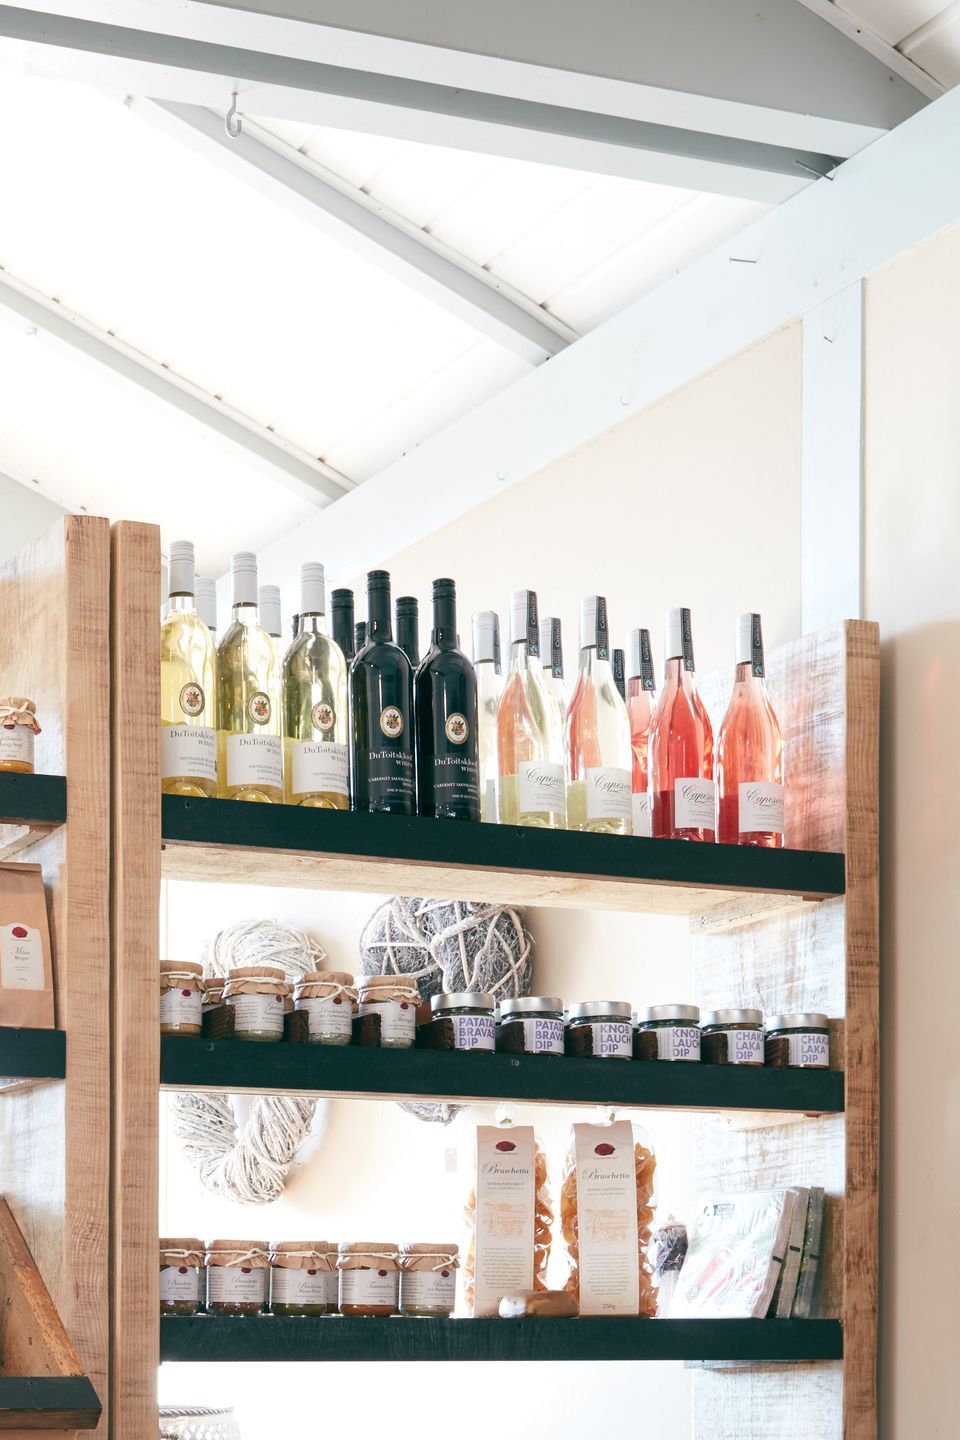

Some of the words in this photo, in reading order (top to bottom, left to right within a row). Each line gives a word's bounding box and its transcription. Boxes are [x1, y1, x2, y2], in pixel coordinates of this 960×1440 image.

[459, 1017, 495, 1029] PATATA
[600, 1023, 630, 1034] KNOB
[672, 1028, 700, 1039] KNOB
[535, 1030, 564, 1041] BRAVA
[600, 1034, 631, 1044] LAUCH
[459, 1037, 478, 1047] DIP
[535, 1041, 553, 1050] DIP
[672, 1038, 700, 1048] LAUCH
[736, 1041, 761, 1051] LAKA
[600, 1043, 618, 1053] DIP
[672, 1048, 690, 1058] DIP
[801, 1044, 826, 1054] LAKA
[736, 1051, 753, 1060] DIP
[801, 1054, 818, 1063] DIP
[482, 1162, 529, 1175] Bruschetta
[582, 1168, 630, 1181] Bruschetta
